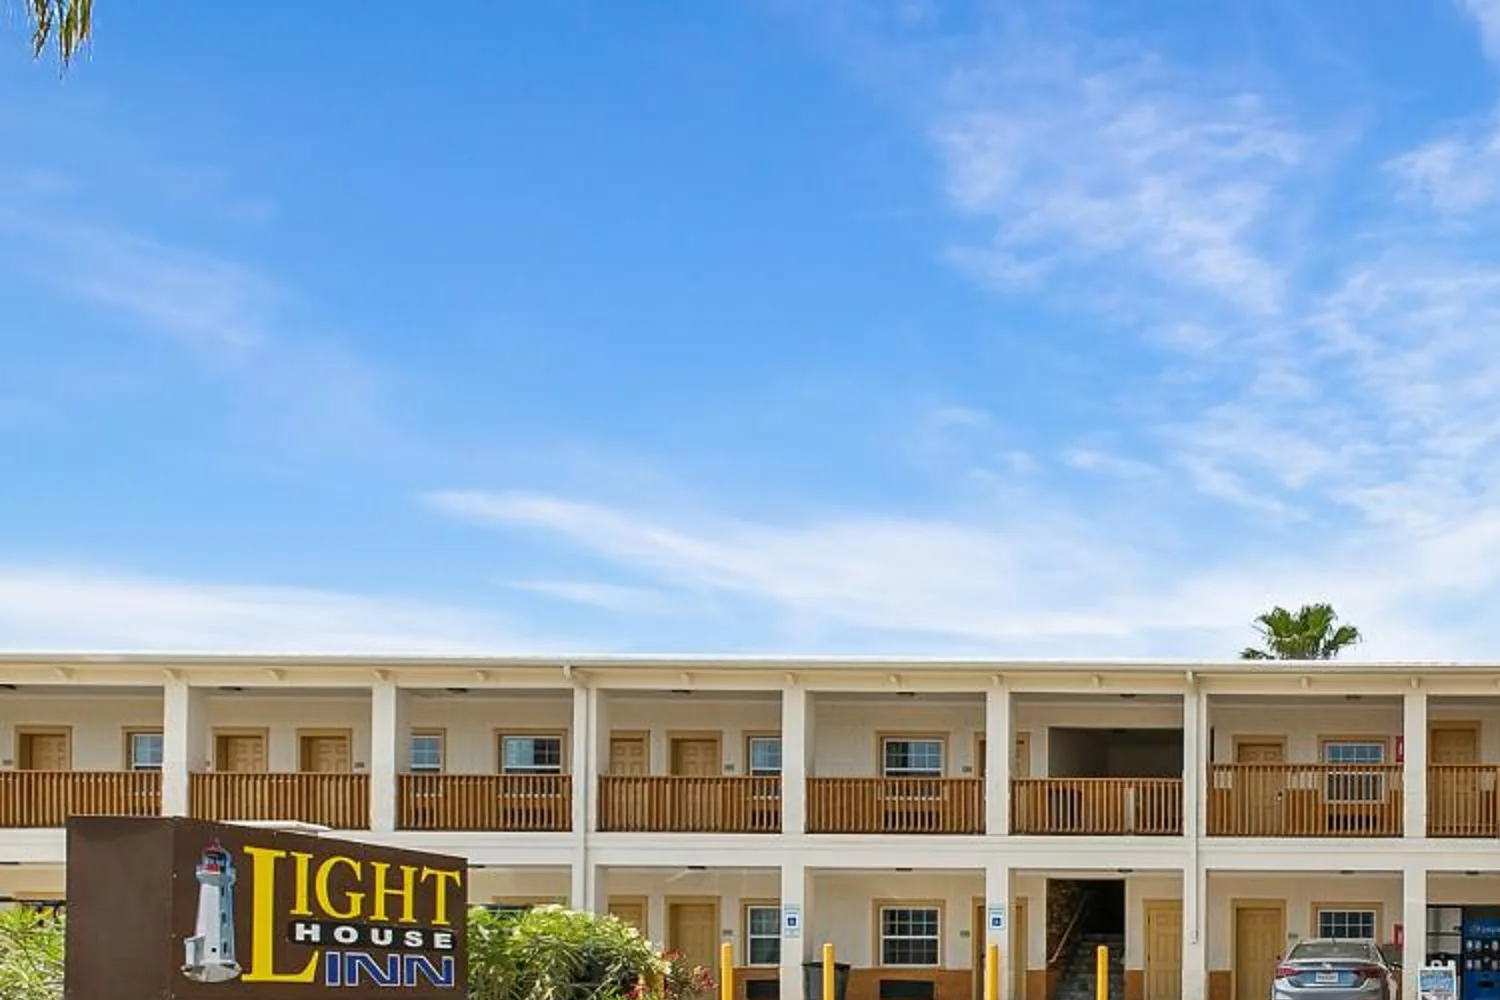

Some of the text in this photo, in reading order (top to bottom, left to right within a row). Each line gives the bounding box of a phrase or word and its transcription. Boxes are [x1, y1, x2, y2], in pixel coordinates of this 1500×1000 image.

[241, 845, 461, 983] LIGHT
[294, 922, 454, 950] HOUSE
[325, 950, 456, 987] INN
